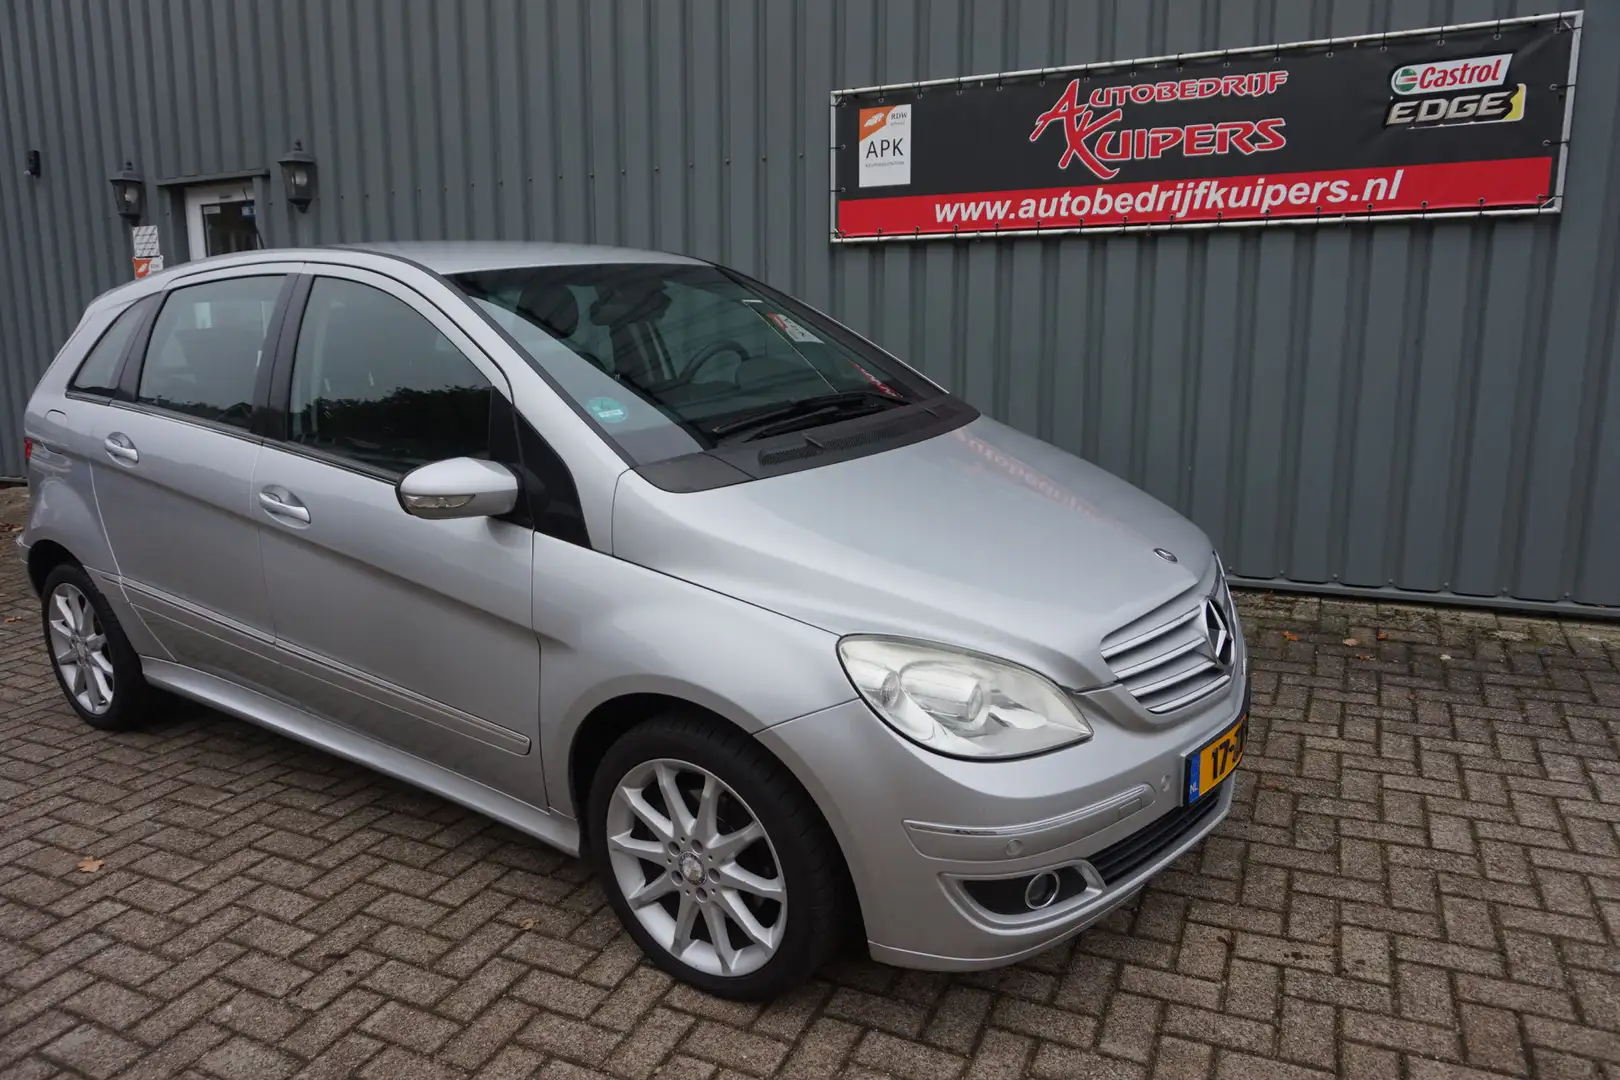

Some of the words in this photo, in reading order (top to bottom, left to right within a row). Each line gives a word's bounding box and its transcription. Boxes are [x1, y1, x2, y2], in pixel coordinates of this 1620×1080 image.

[1419, 59, 1502, 89] Castrol
[1386, 91, 1512, 125] EDGE
[866, 137, 904, 159] APK
[1058, 108, 1286, 179] KUIPERS
[935, 169, 1404, 223] www.autobedrijfkuipers.nl
